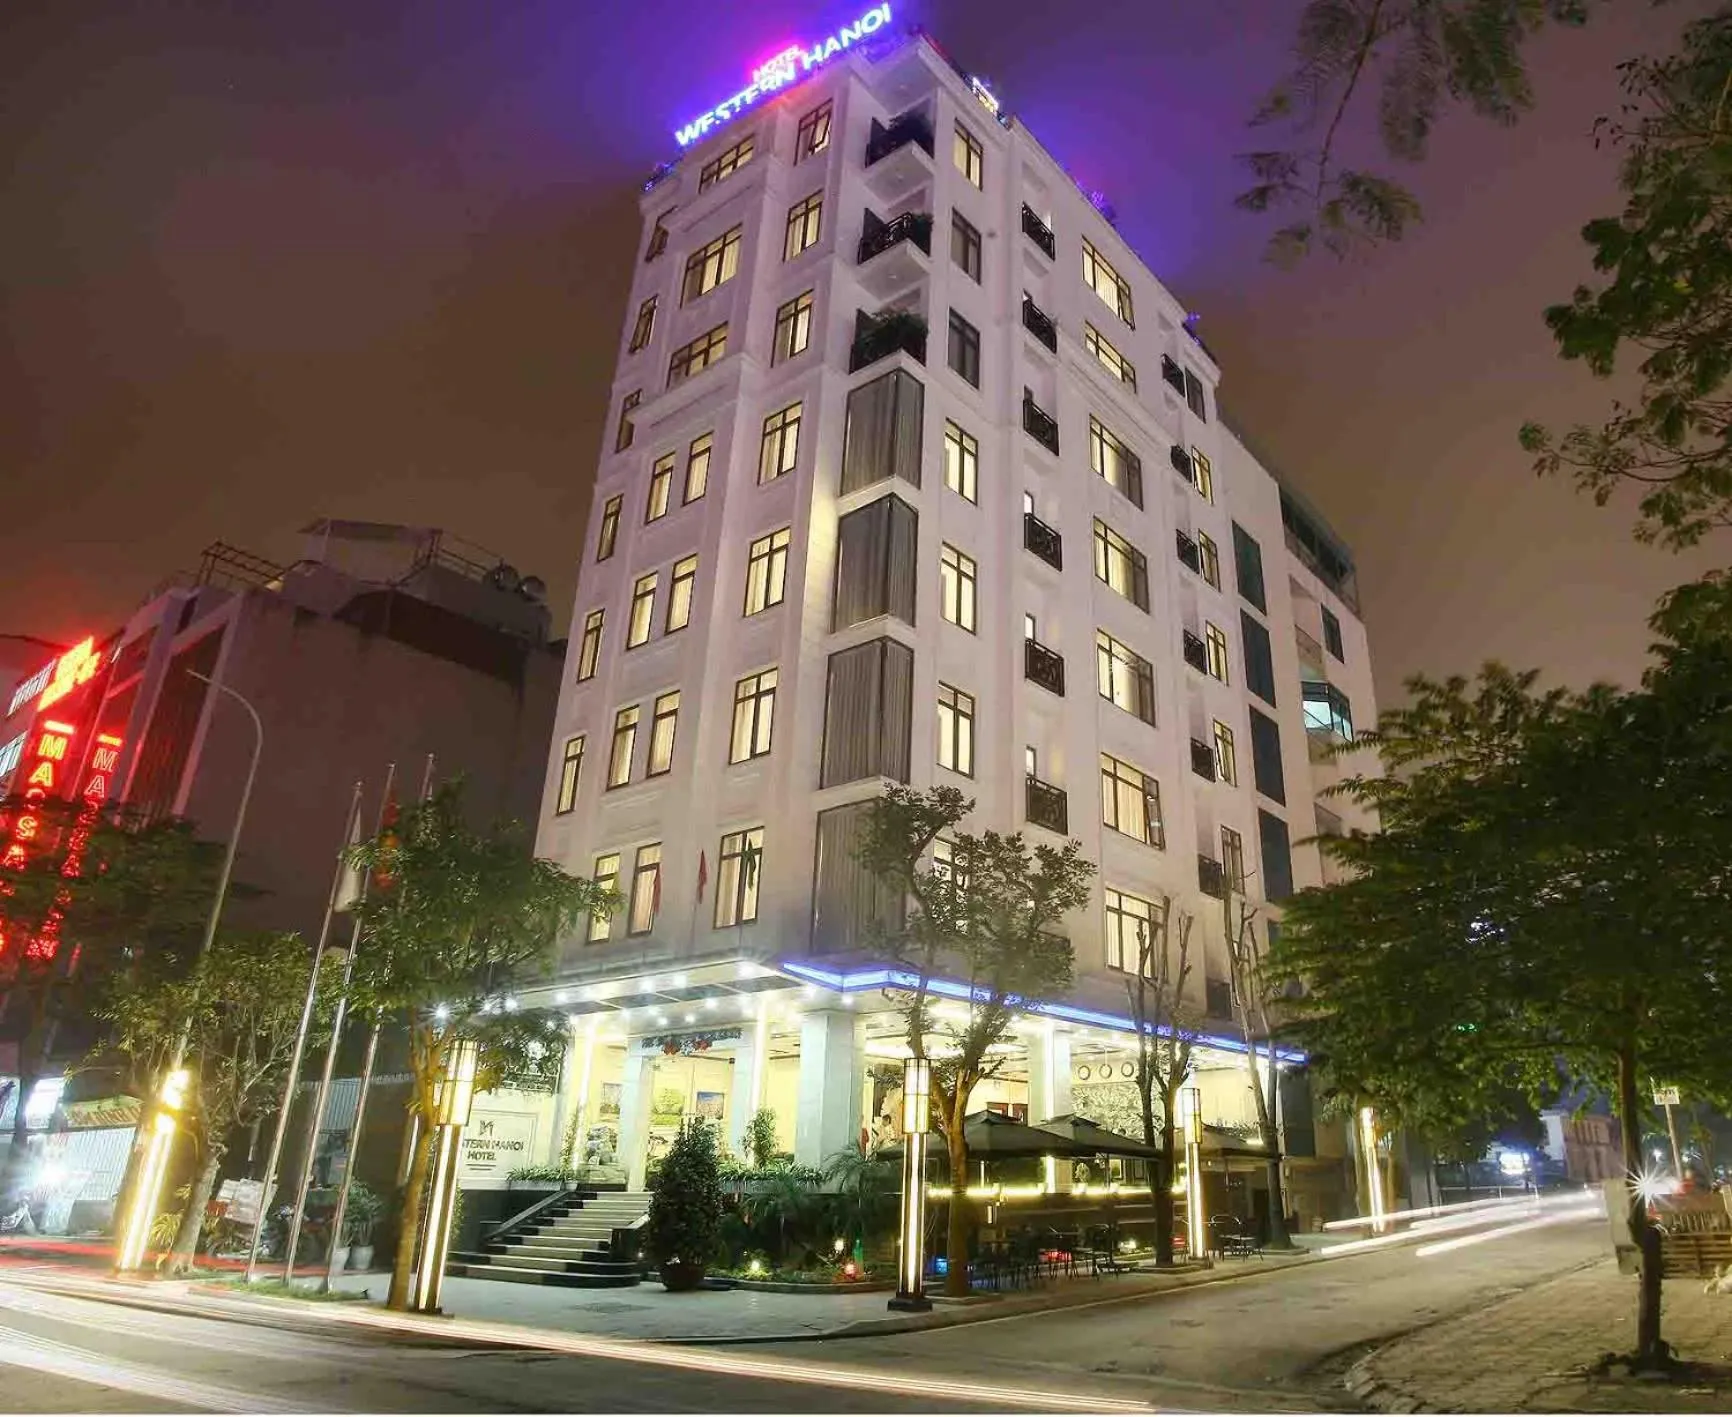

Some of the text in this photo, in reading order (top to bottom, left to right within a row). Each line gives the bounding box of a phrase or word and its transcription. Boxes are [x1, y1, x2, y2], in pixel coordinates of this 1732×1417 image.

[802, 2, 892, 70] HANOI
[462, 1138, 490, 1150] TERN
[467, 1150, 497, 1161] HOTEL
